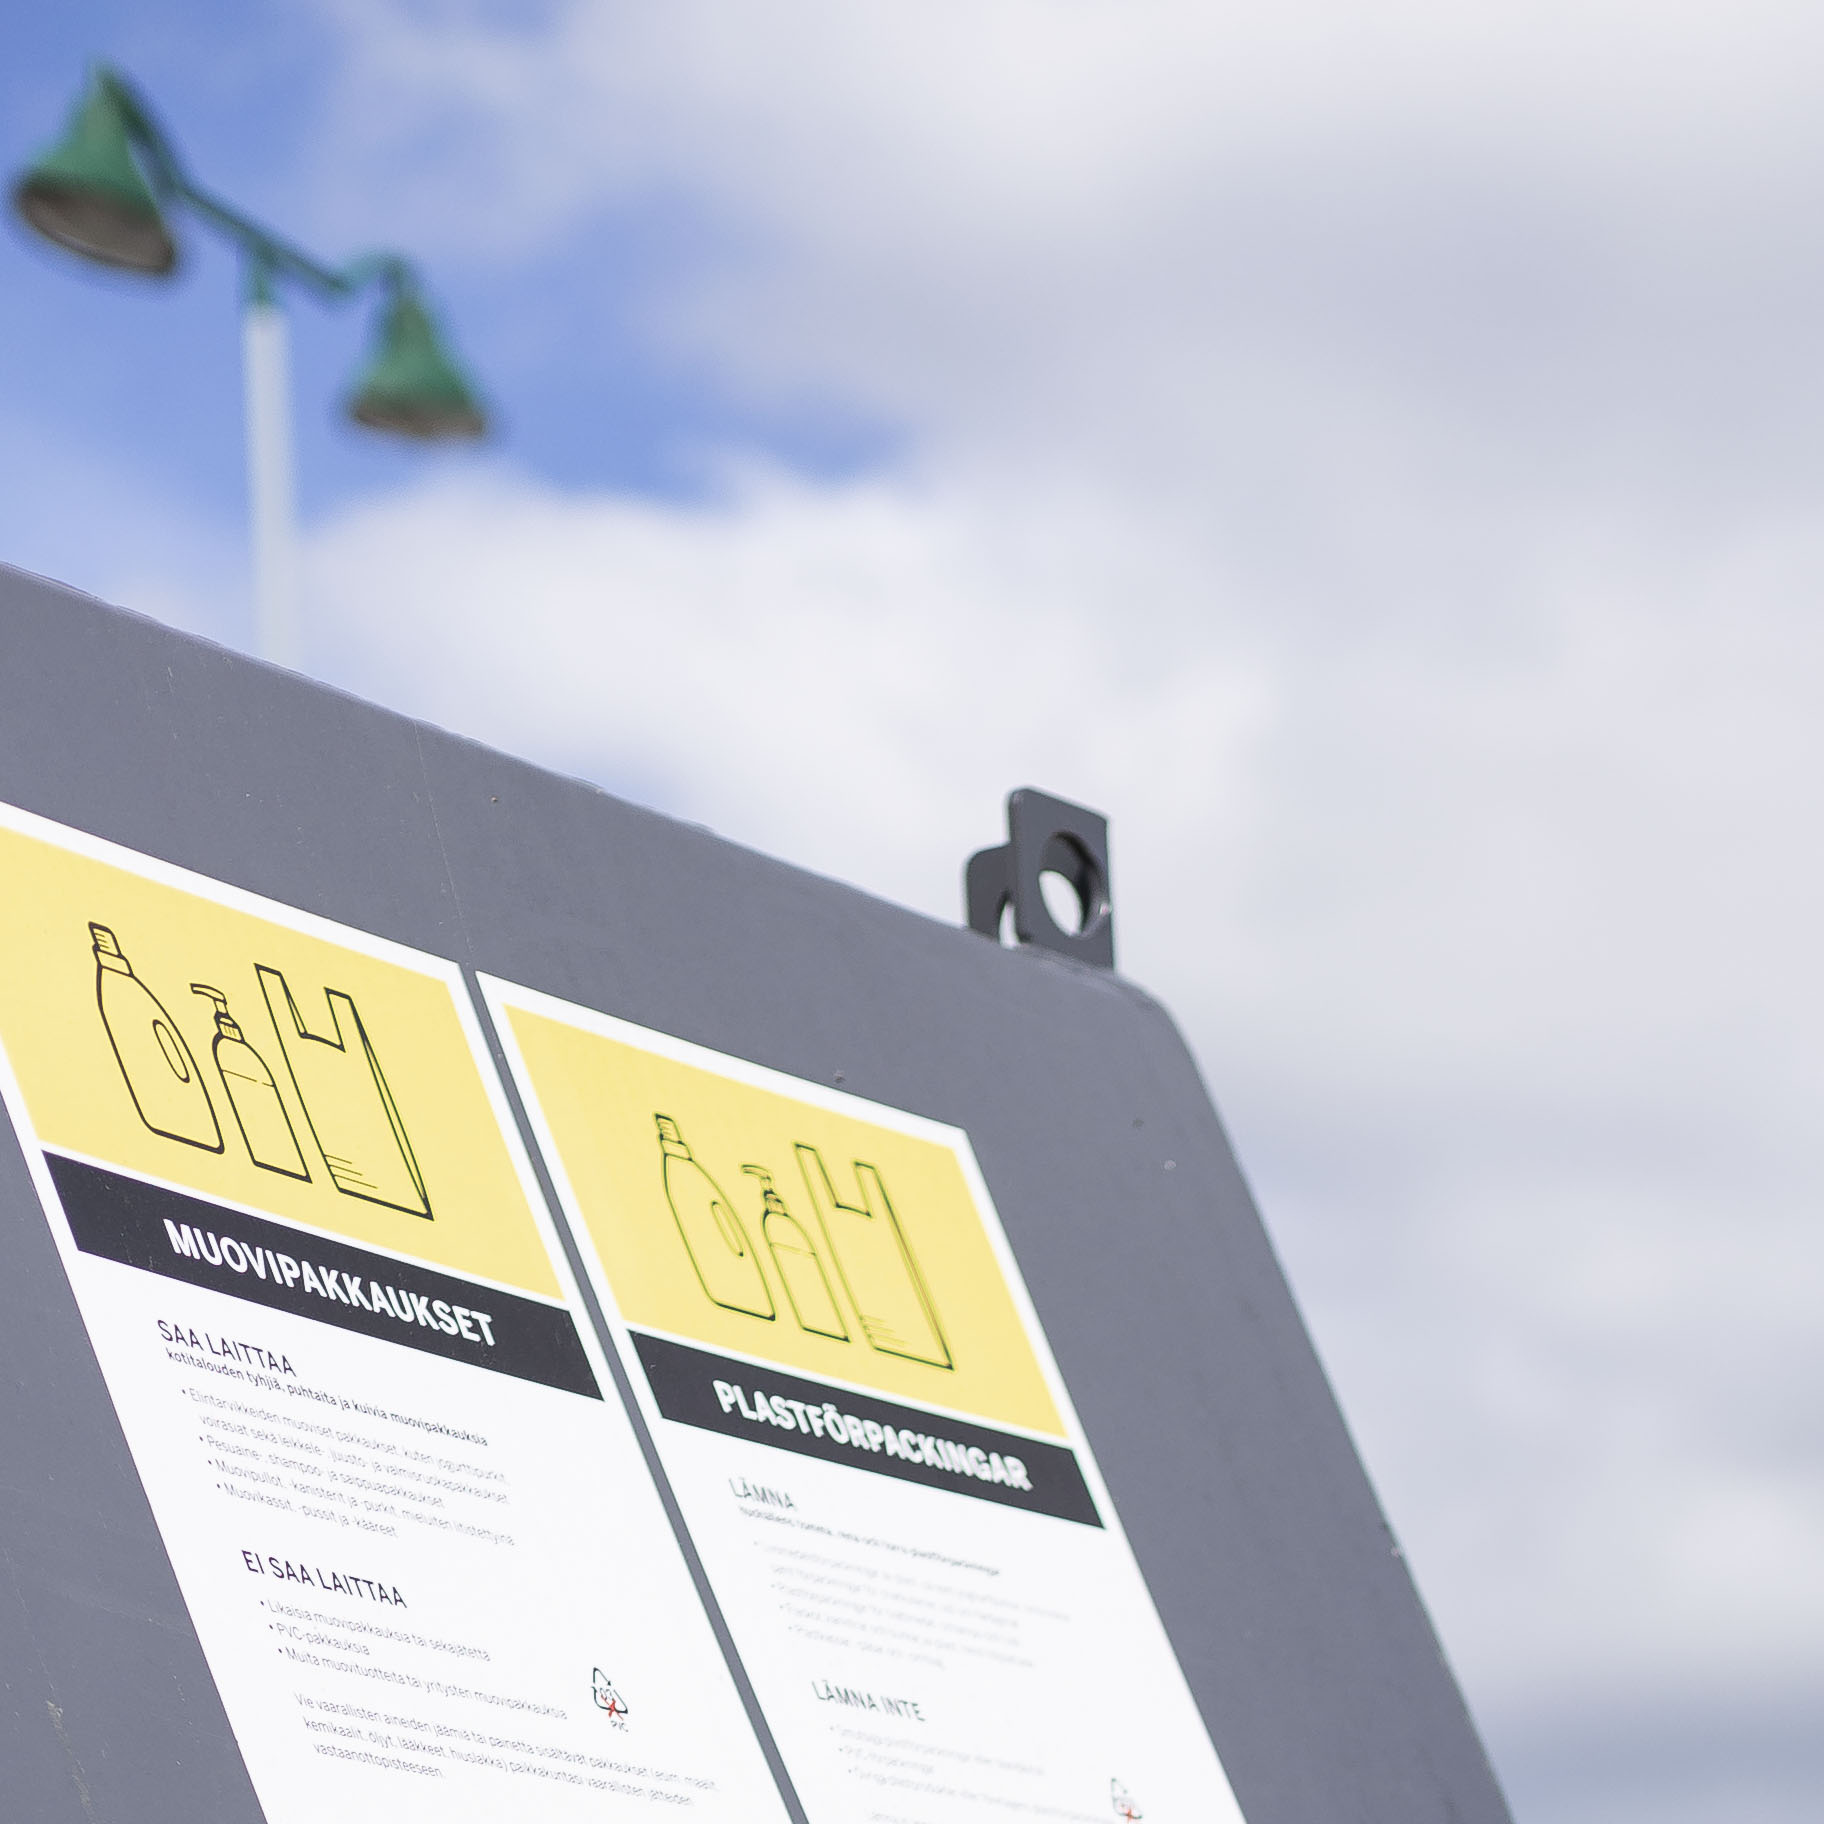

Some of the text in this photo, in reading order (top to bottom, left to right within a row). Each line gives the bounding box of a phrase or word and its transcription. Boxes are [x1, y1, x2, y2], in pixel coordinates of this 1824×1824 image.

[163, 1218, 496, 1347] MUOVIPAKKAUKSET
[157, 1319, 297, 1377] SAA LAITTAA
[166, 1348, 244, 1383] kotitalouden
[287, 1381, 337, 1406] puhtaita
[338, 1394, 351, 1412] ja
[352, 1399, 387, 1420] kuivia
[390, 1410, 488, 1447] muovipakkauksia
[729, 1477, 796, 1509] LÄMNA
[241, 1550, 407, 1608] EI SAA LAITTAA
[812, 1679, 926, 1722] LÄMNA INTE
